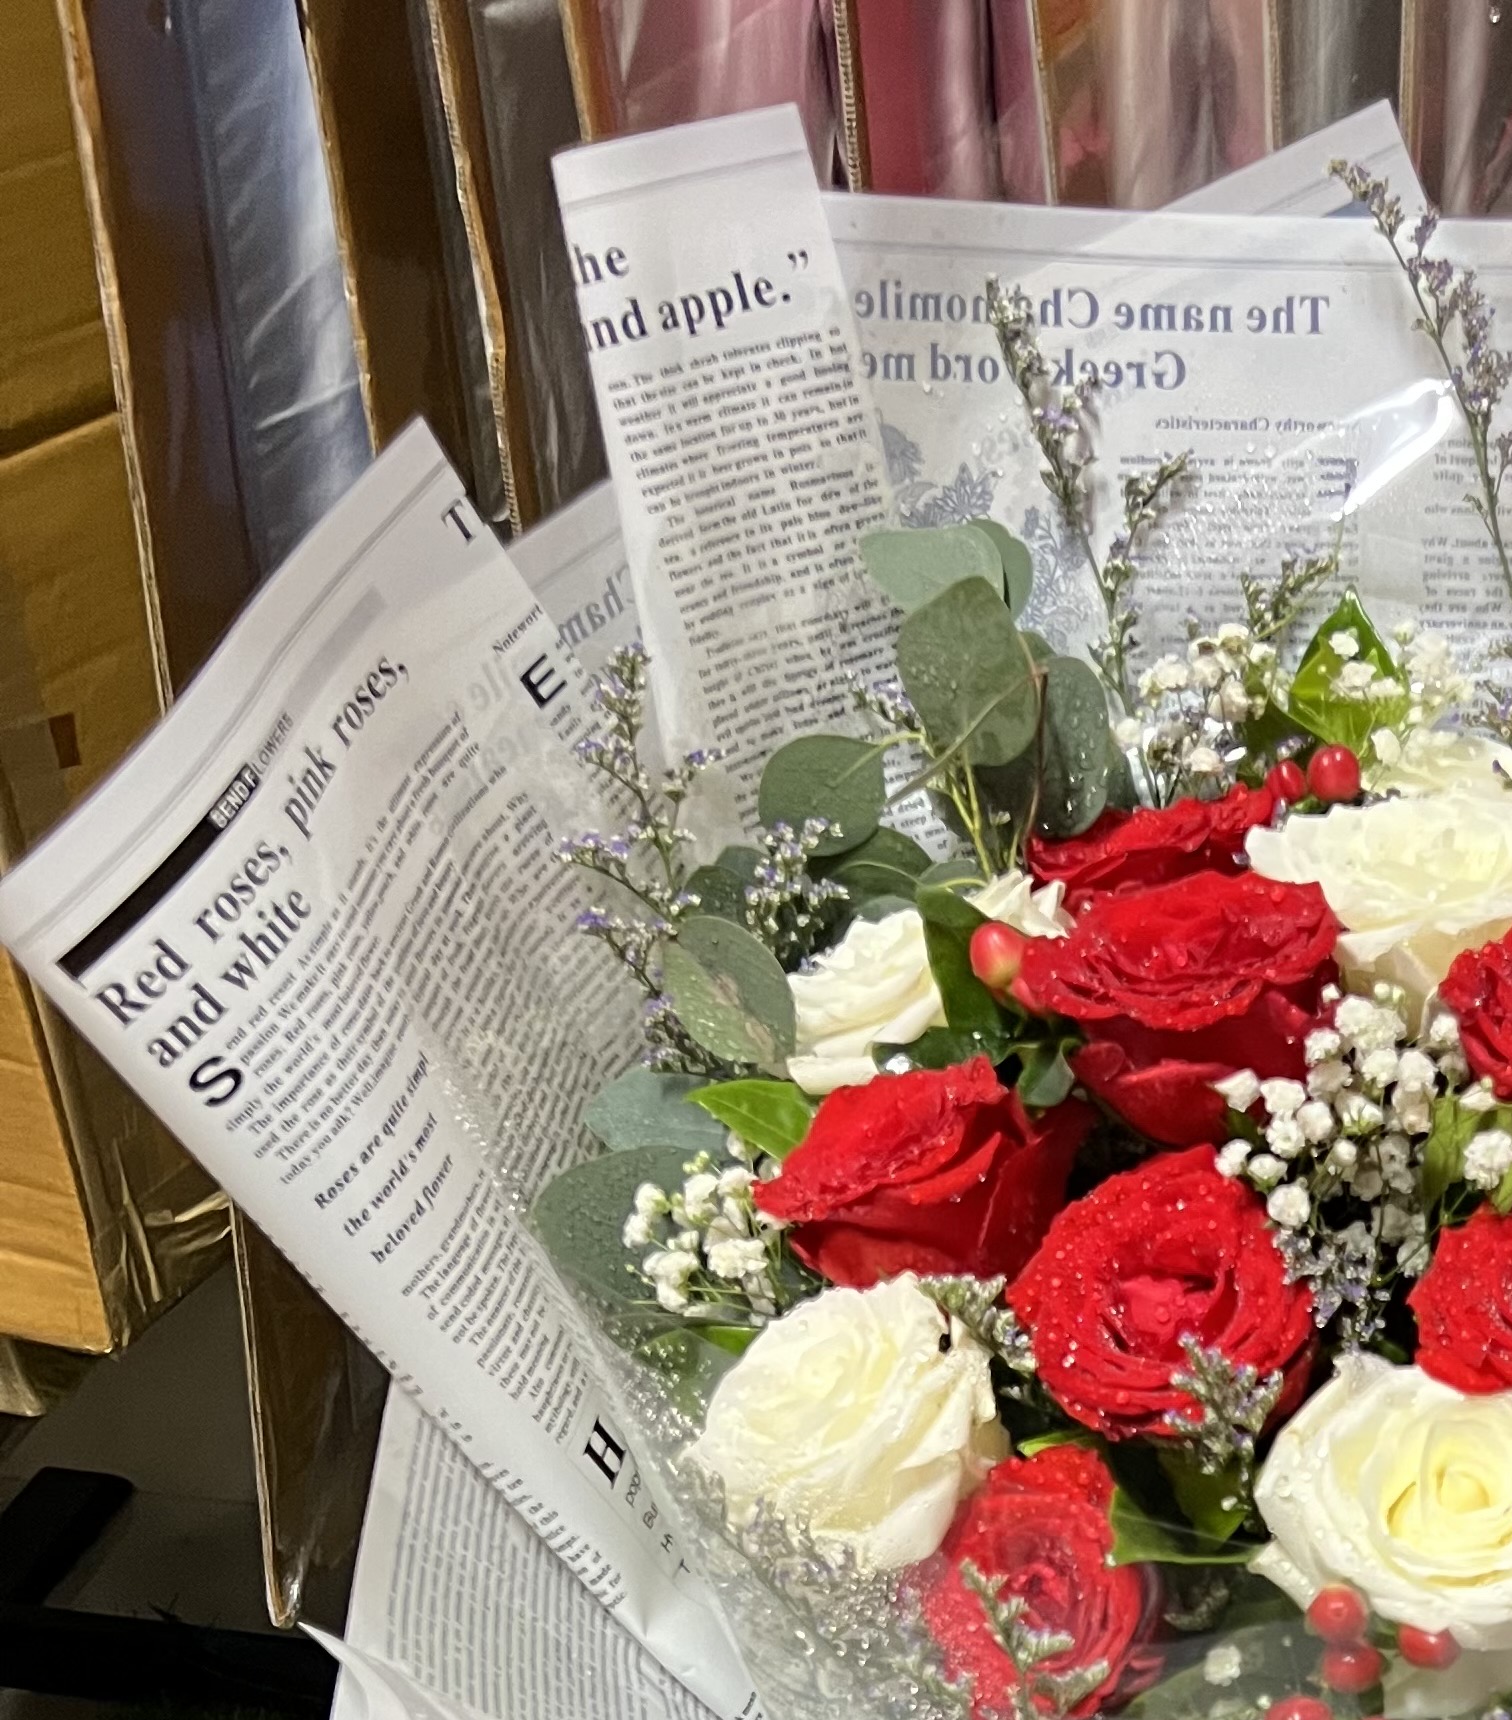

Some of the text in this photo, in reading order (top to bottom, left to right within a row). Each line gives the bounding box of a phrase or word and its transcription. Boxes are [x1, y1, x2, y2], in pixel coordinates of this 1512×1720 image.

[573, 241, 630, 286] he
[584, 298, 648, 353] nd
[94, 657, 408, 1026] Red roses, pink roses,
[147, 890, 310, 1068] and white
[314, 1165, 359, 1209] Roses
[360, 1134, 380, 1164] are
[382, 1094, 408, 1137] quite
[343, 1208, 370, 1236] the
[370, 1150, 417, 1209] world's
[370, 1154, 453, 1264] beloved flower
